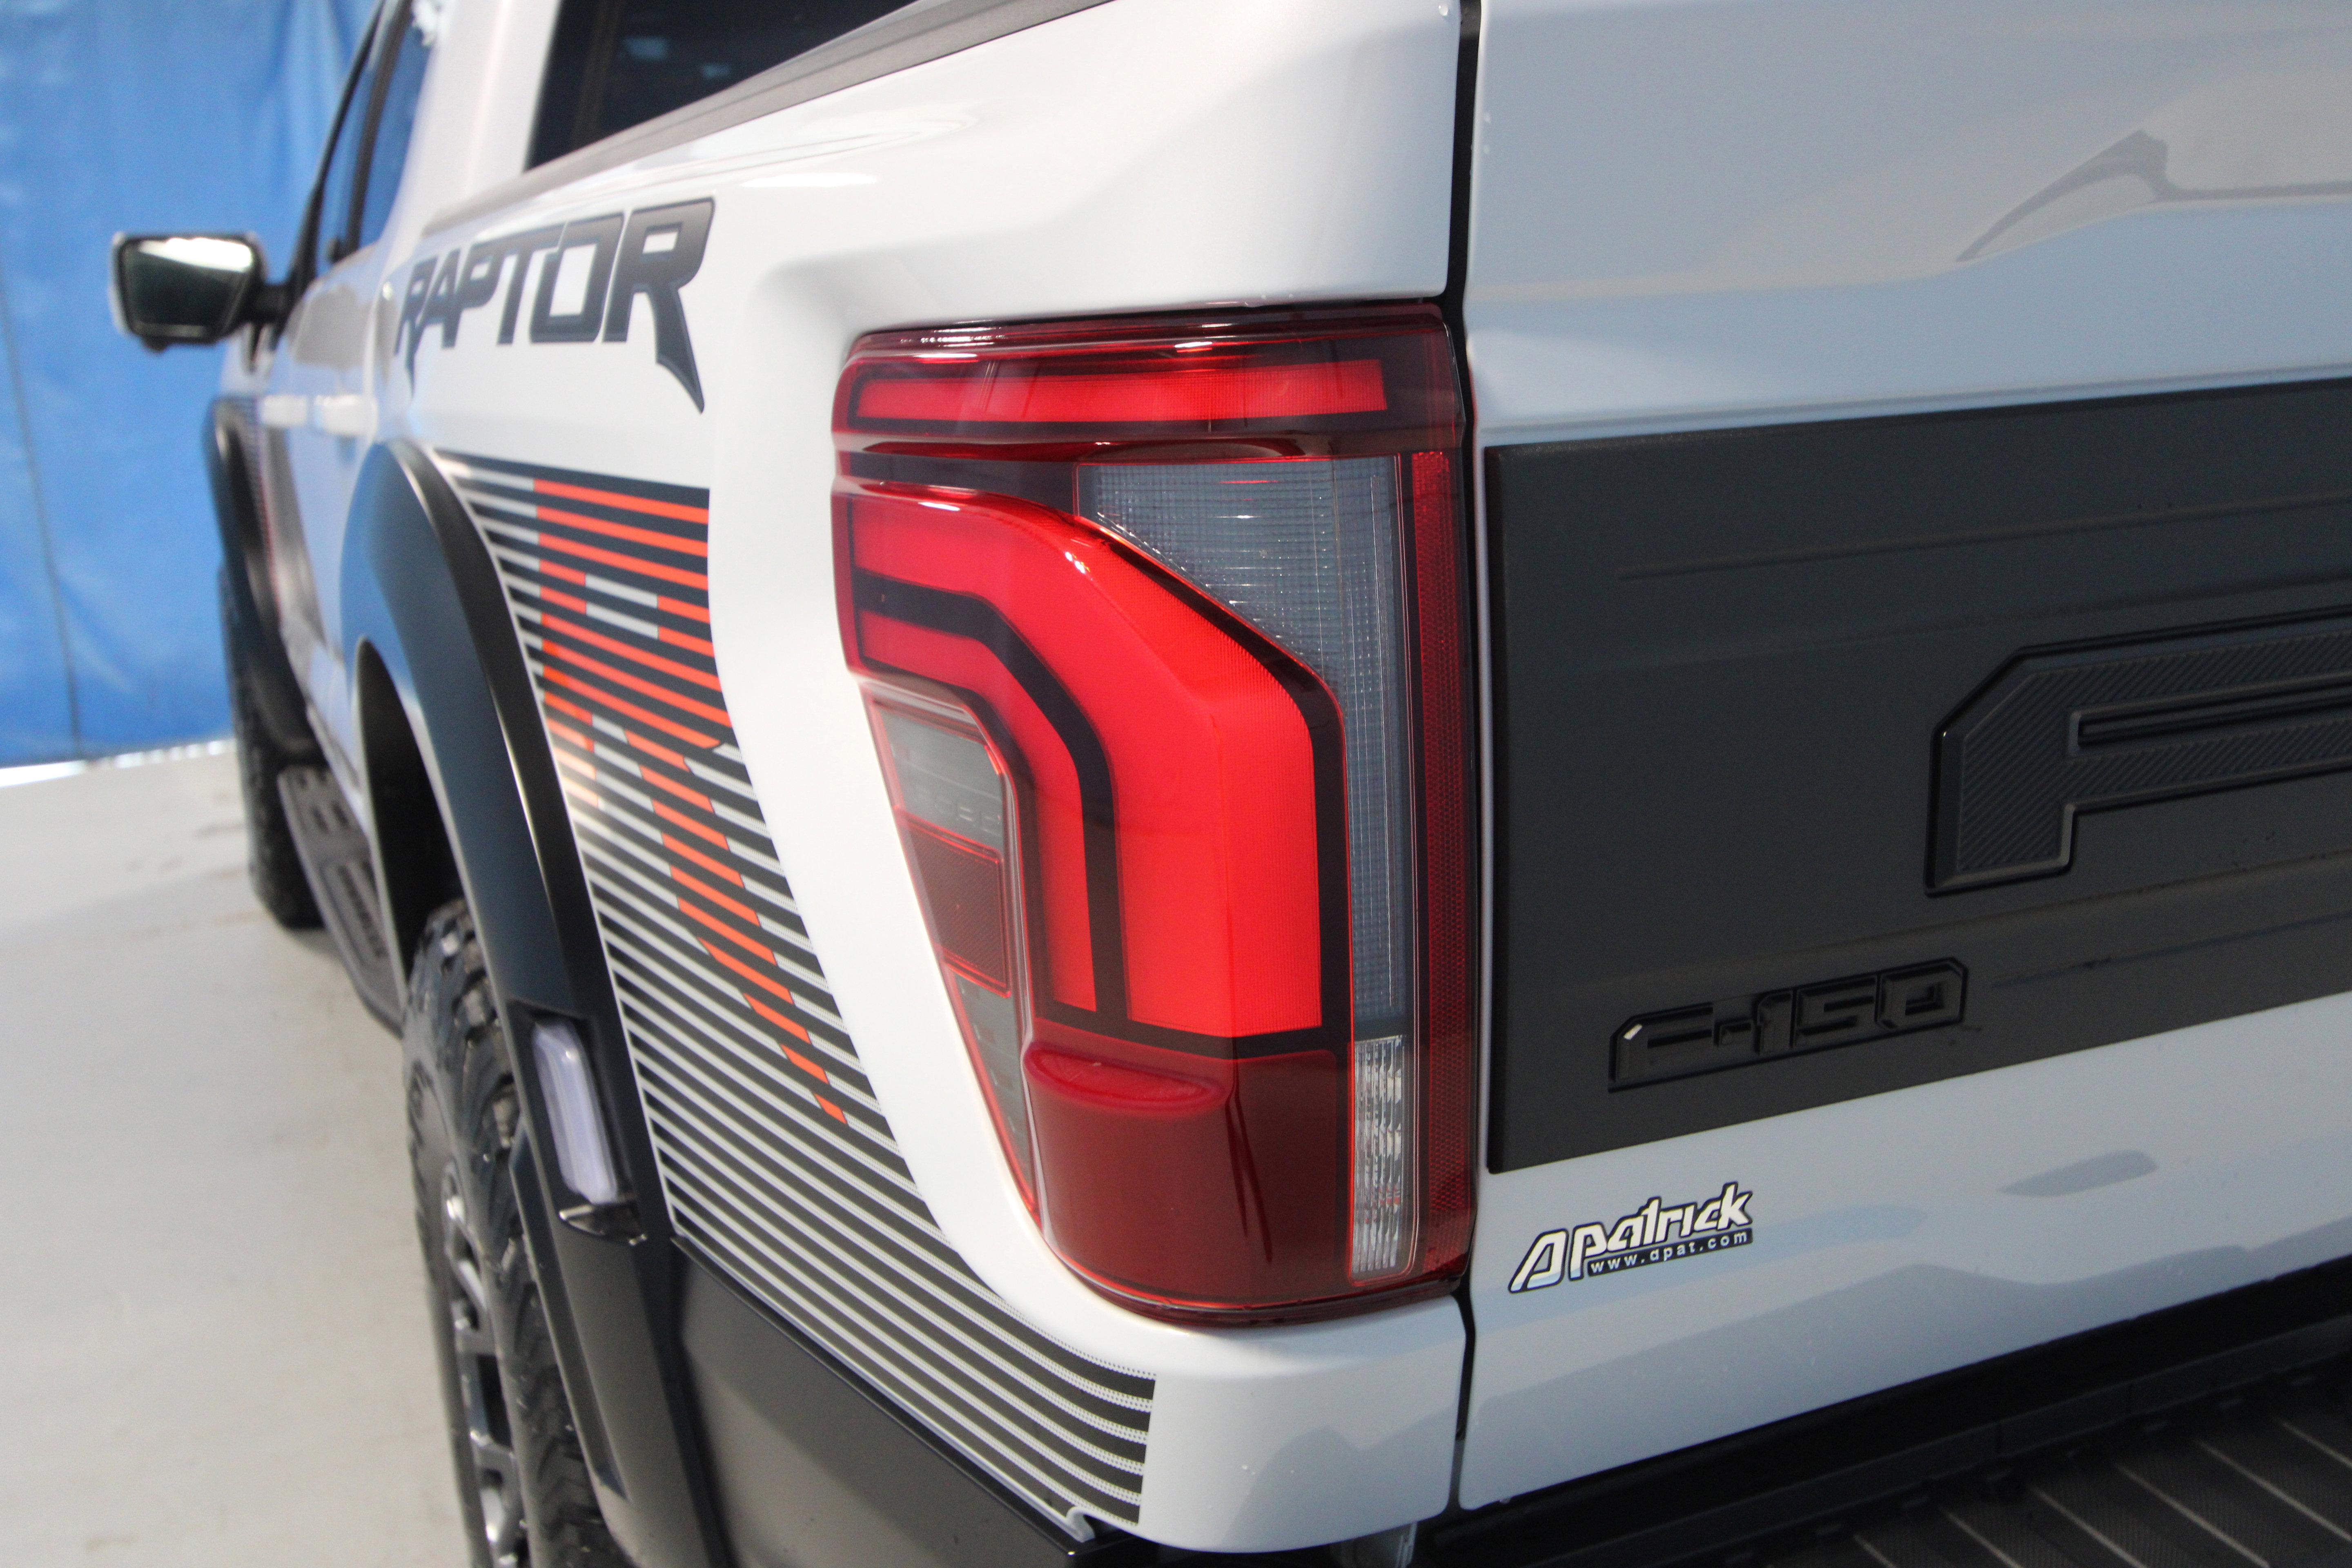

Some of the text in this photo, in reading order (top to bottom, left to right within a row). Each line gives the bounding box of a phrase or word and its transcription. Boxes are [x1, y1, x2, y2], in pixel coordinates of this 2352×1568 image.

[394, 196, 715, 414] RAPTOR
[1608, 957, 1968, 1093] F-150
[1590, 1230, 1748, 1274] www.dpat.com
